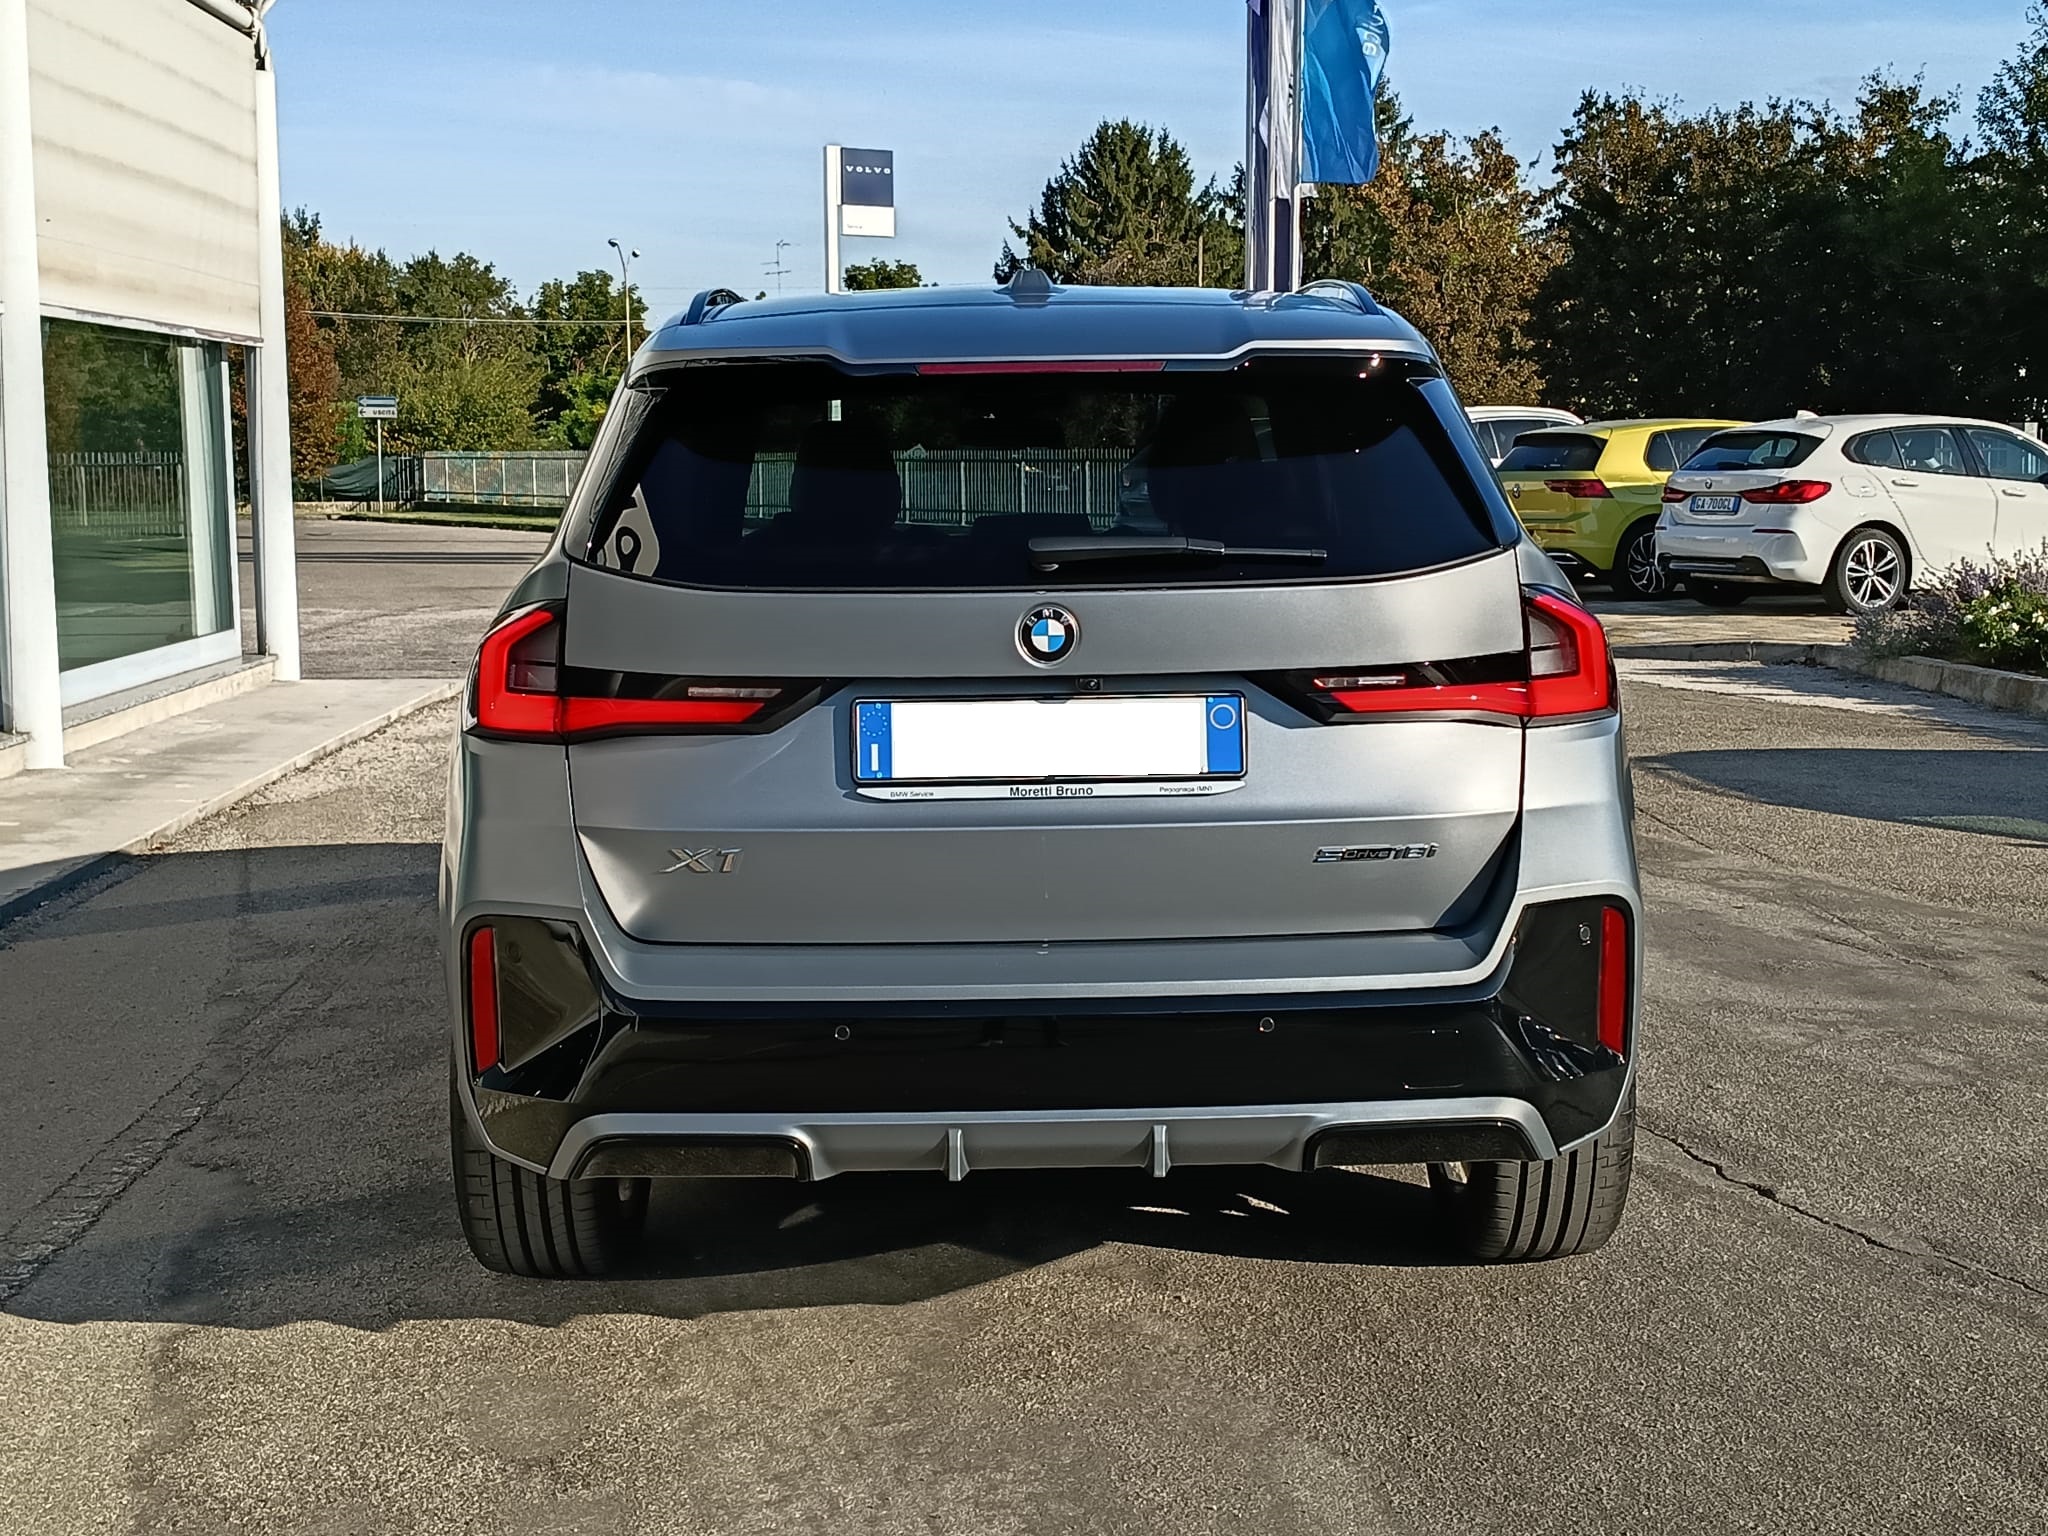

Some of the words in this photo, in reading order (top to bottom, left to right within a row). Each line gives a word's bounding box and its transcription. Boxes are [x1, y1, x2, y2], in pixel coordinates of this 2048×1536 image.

[845, 165, 892, 175] VOLVO
[1026, 608, 1071, 627] BMW
[1009, 786, 1052, 798] Moretti
[1056, 785, 1094, 796] Bruno
[658, 848, 743, 873] X1
